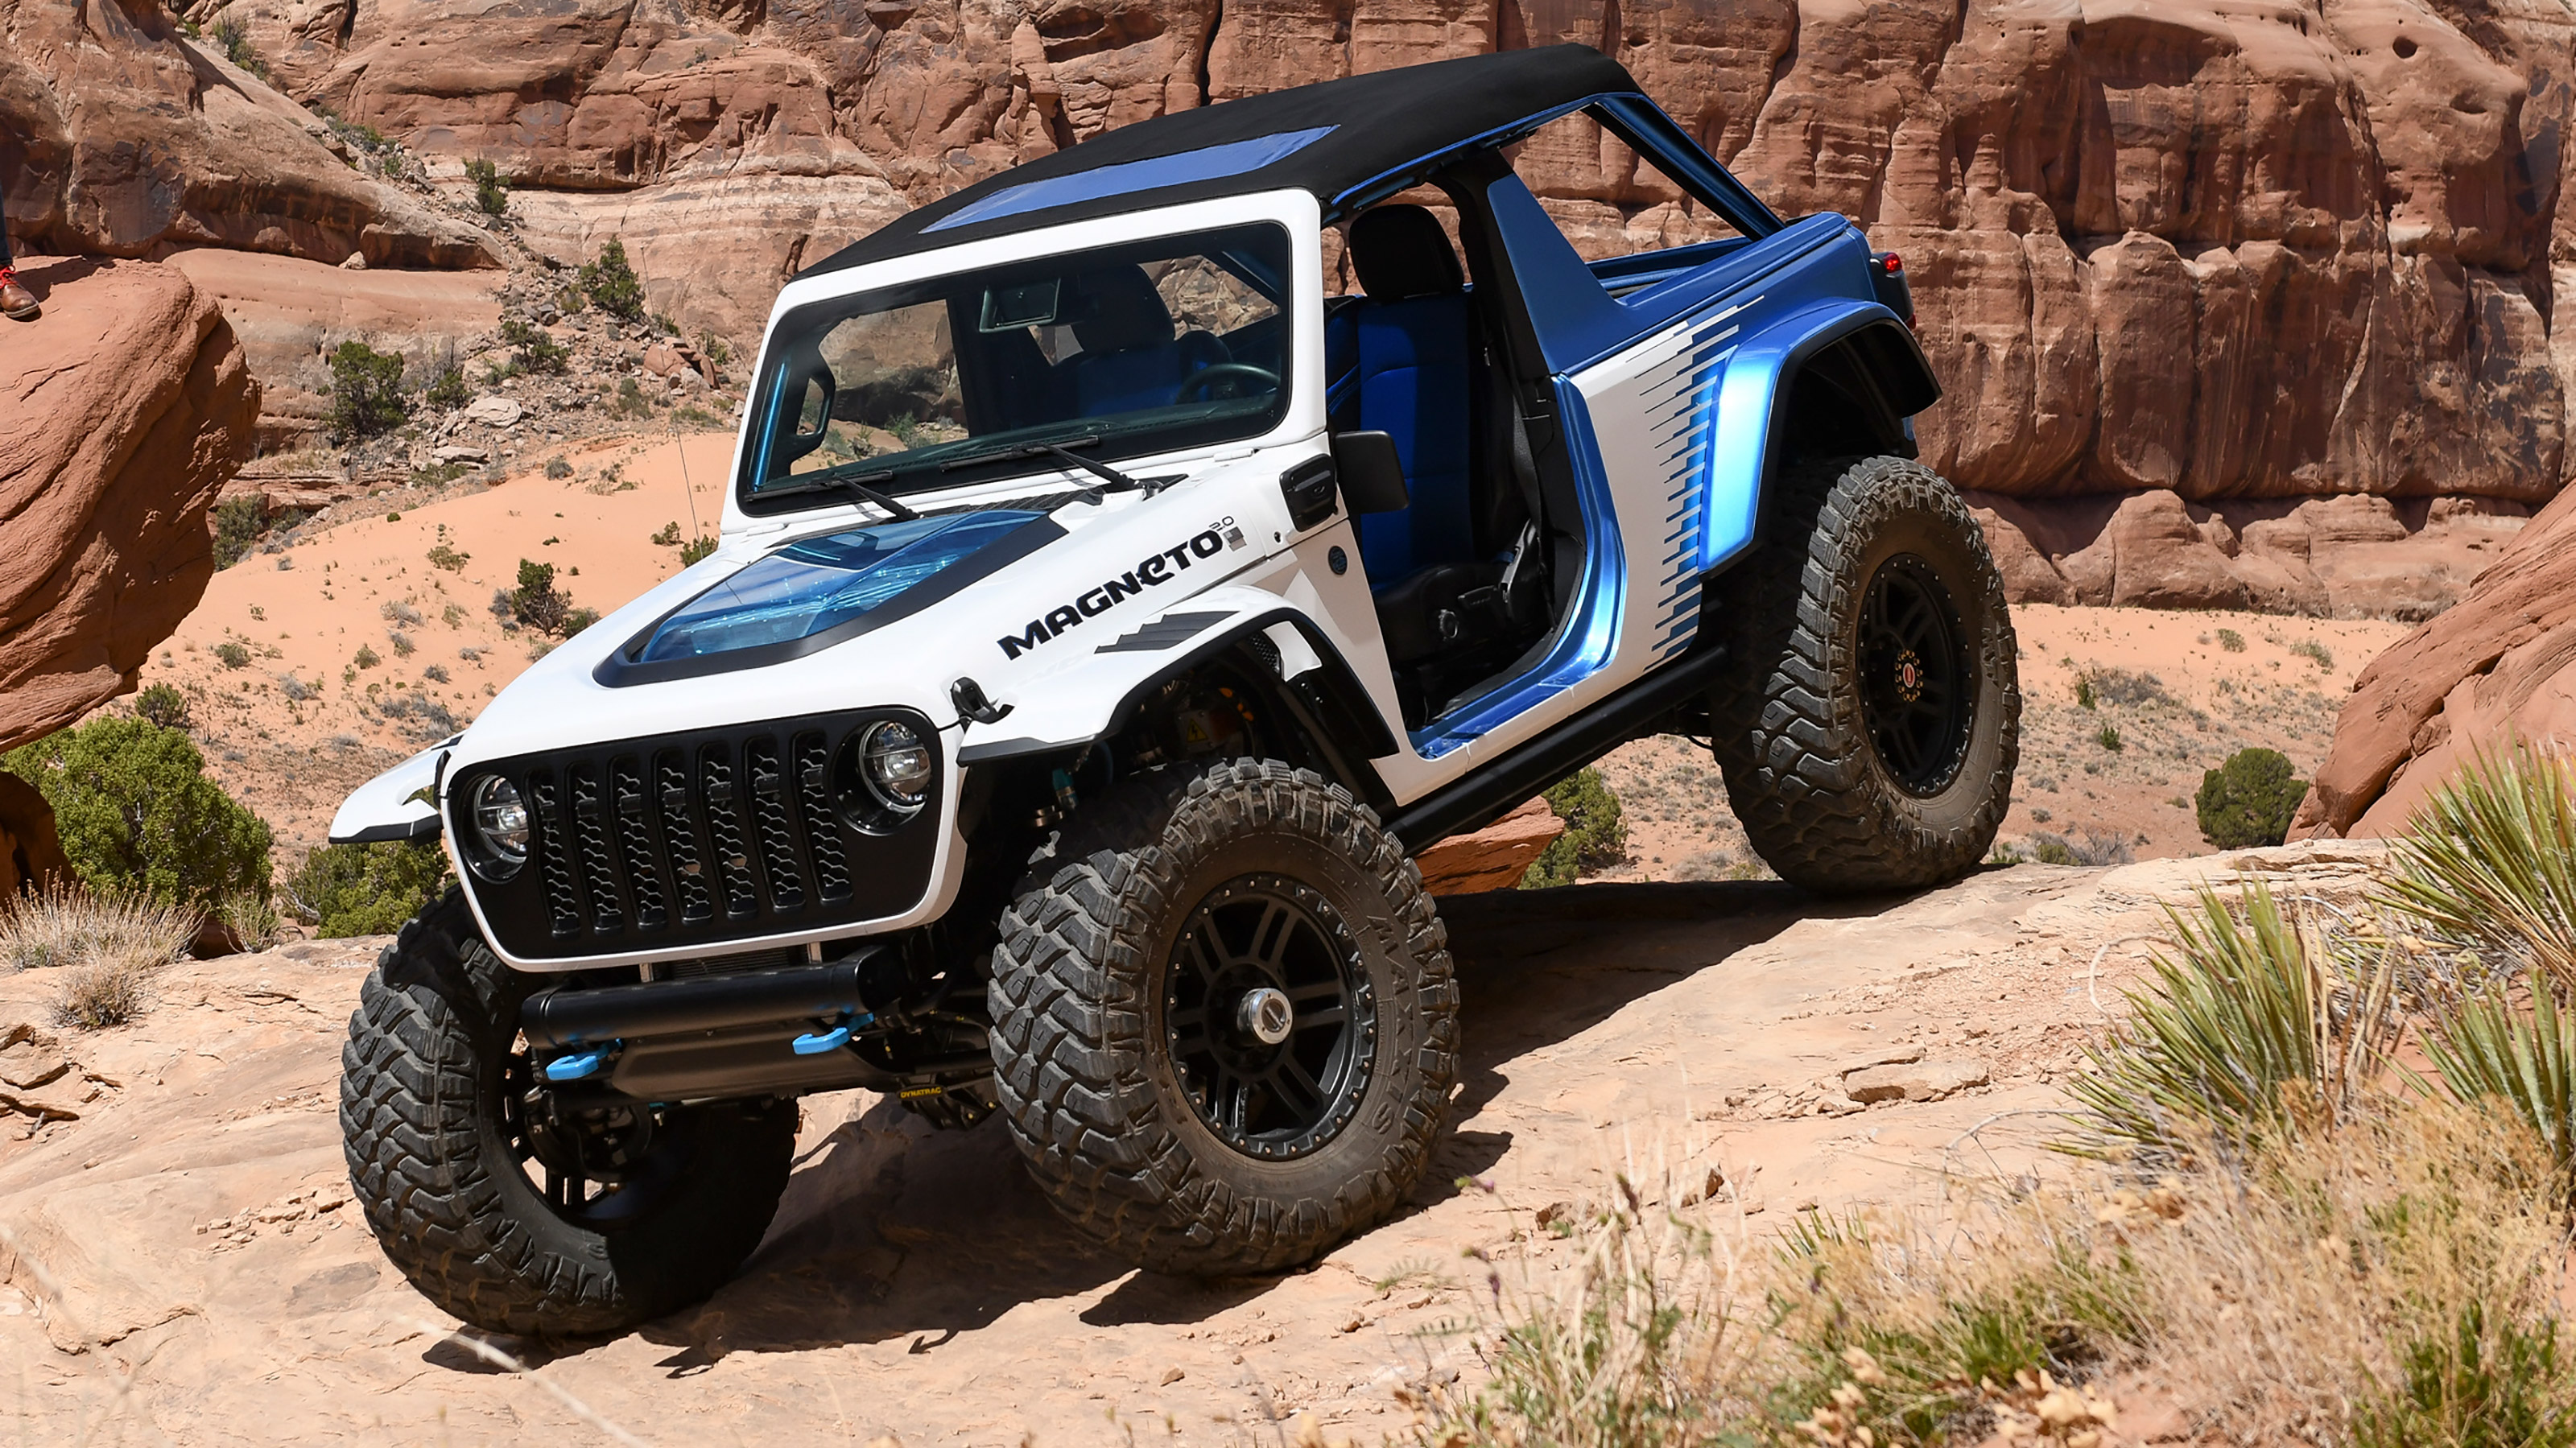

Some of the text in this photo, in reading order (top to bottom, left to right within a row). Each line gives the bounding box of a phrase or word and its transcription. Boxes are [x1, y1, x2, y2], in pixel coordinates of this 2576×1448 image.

[1208, 515, 1234, 531] 2.0
[1367, 916, 1412, 1136] MAXXIS
[901, 1087, 942, 1099] DYNATRAC
